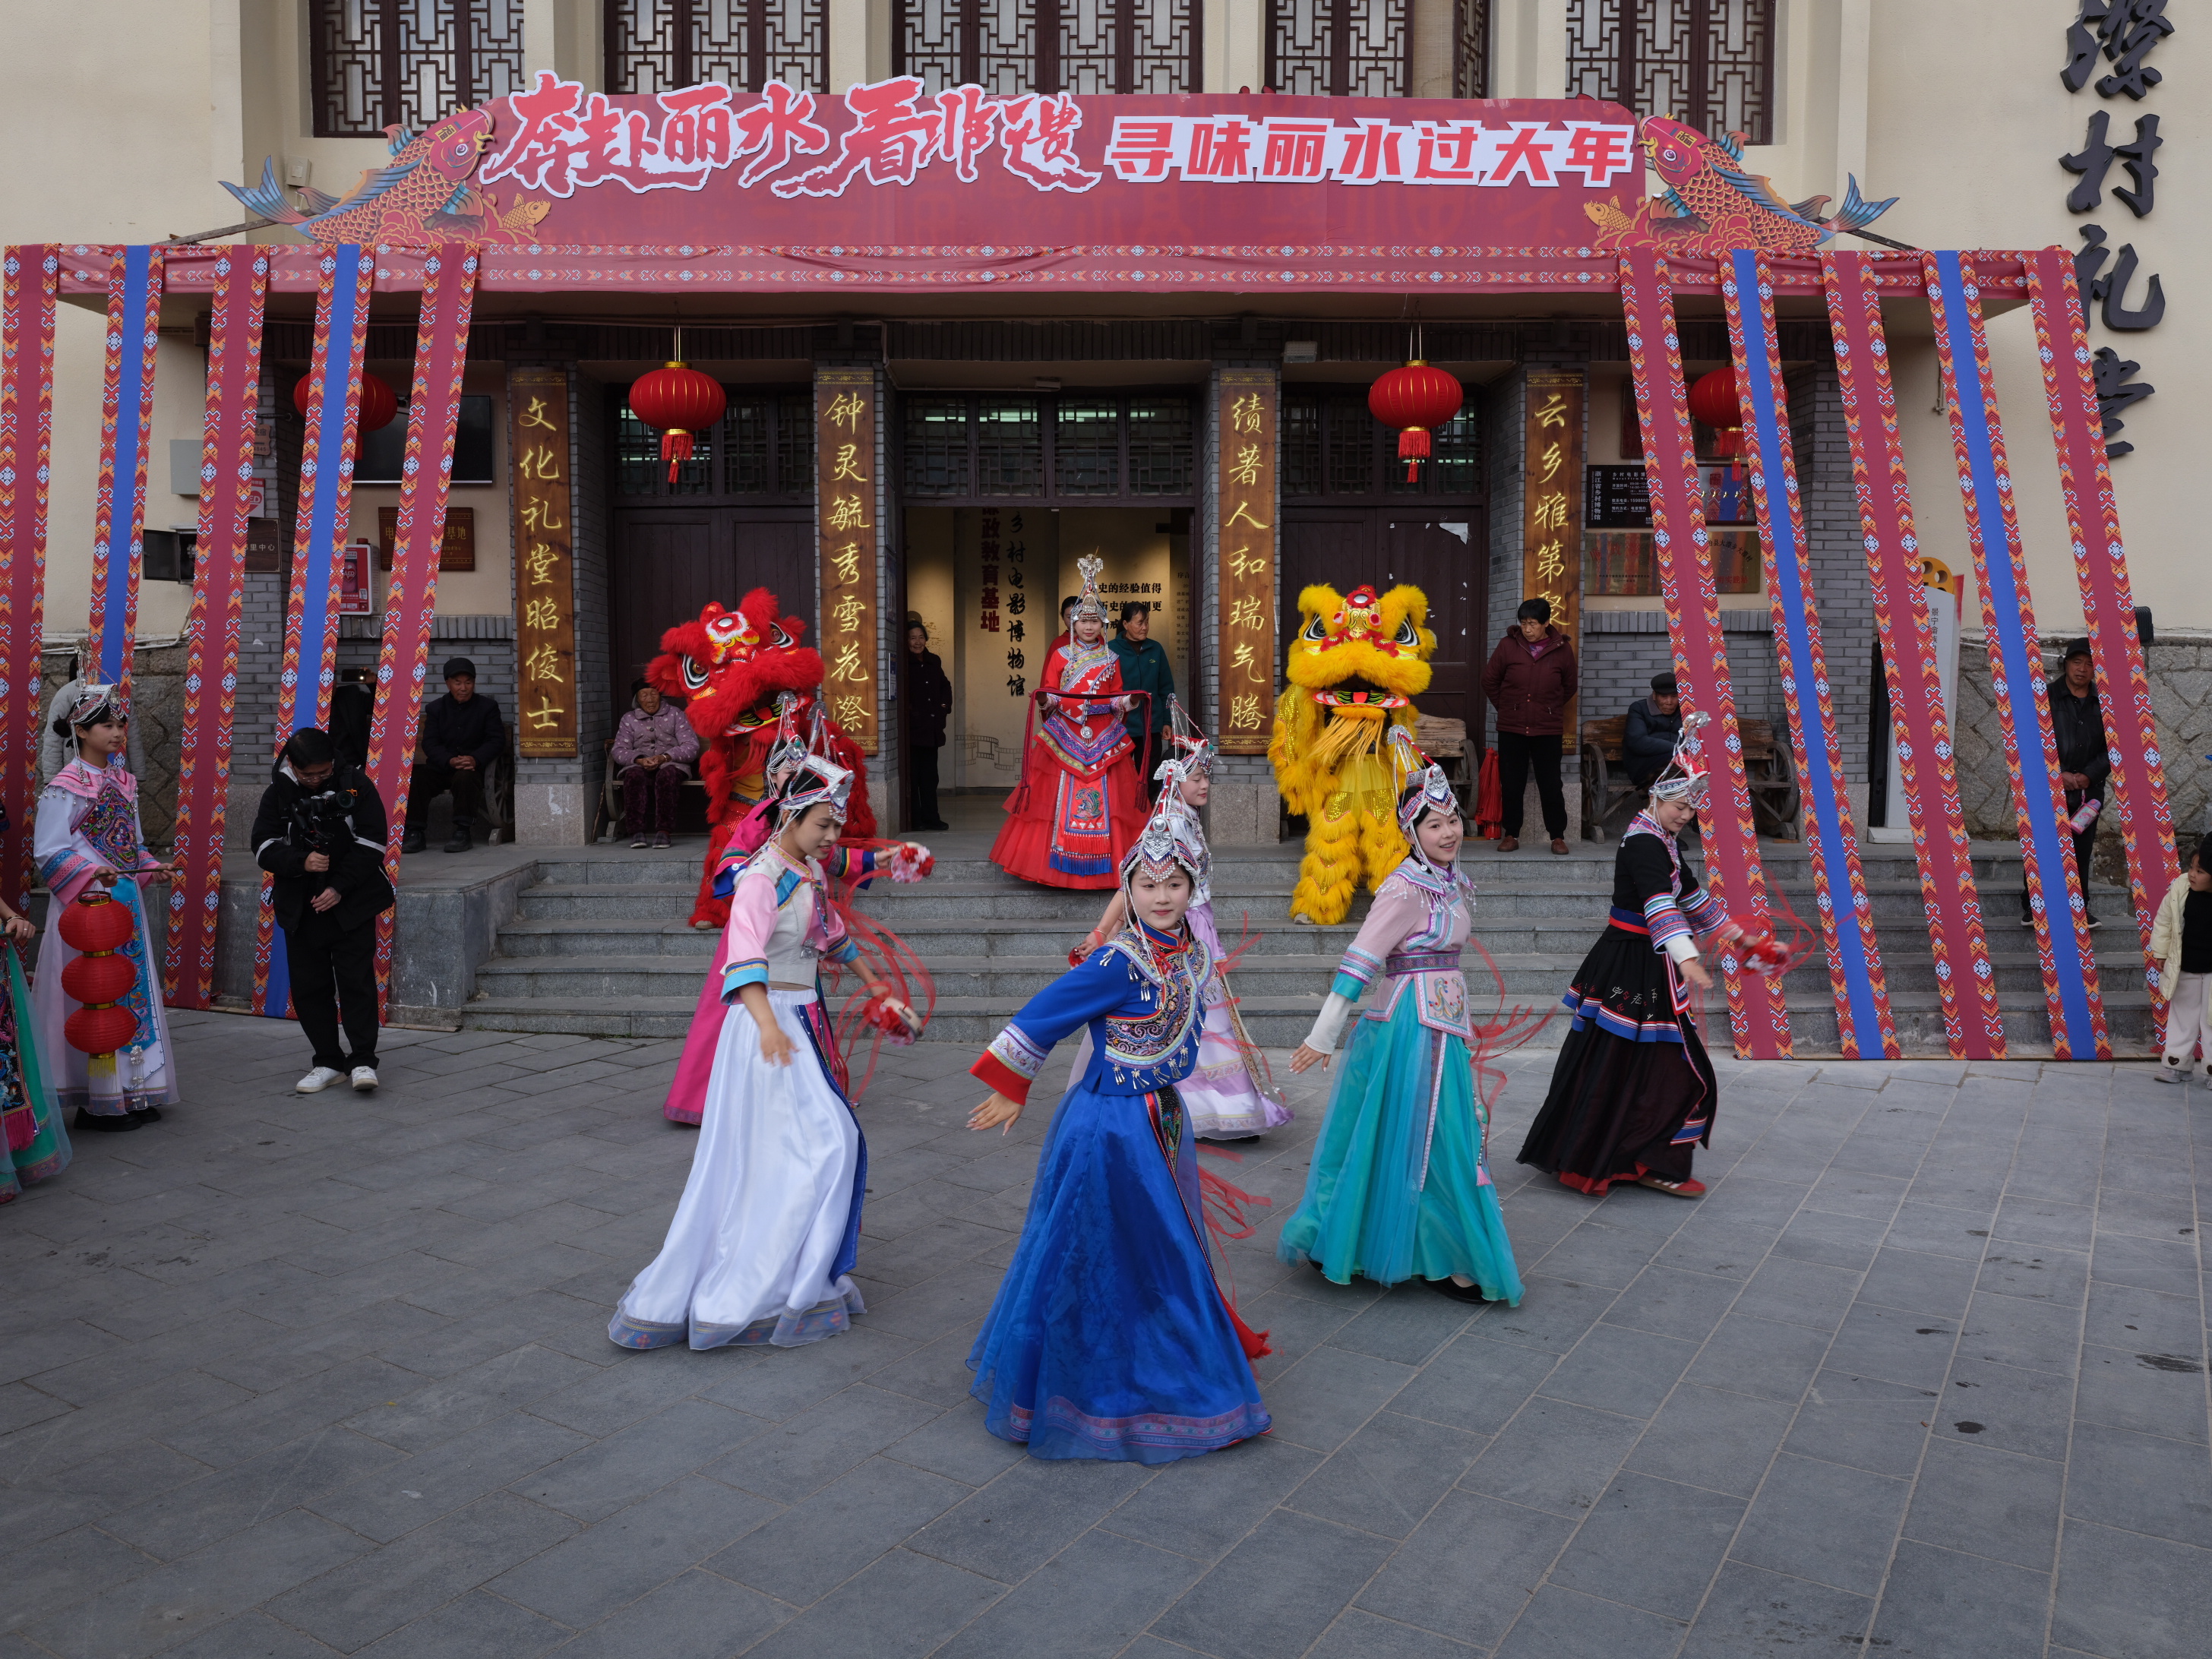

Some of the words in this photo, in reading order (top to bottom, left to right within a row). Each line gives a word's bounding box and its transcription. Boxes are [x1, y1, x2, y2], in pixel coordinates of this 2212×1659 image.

[480, 70, 1101, 198] 奔赴丽水看非遗
[1106, 116, 1634, 188] 寻味丽水过大年
[518, 394, 565, 730] 文化礼堂昭俊士
[1006, 510, 1026, 697] 乡村电影博物馆
[1096, 582, 1162, 594] 史的经验值得
[1224, 391, 1269, 732] 绩著人和瑞气腾
[1714, 575, 1749, 584] 明实践站
